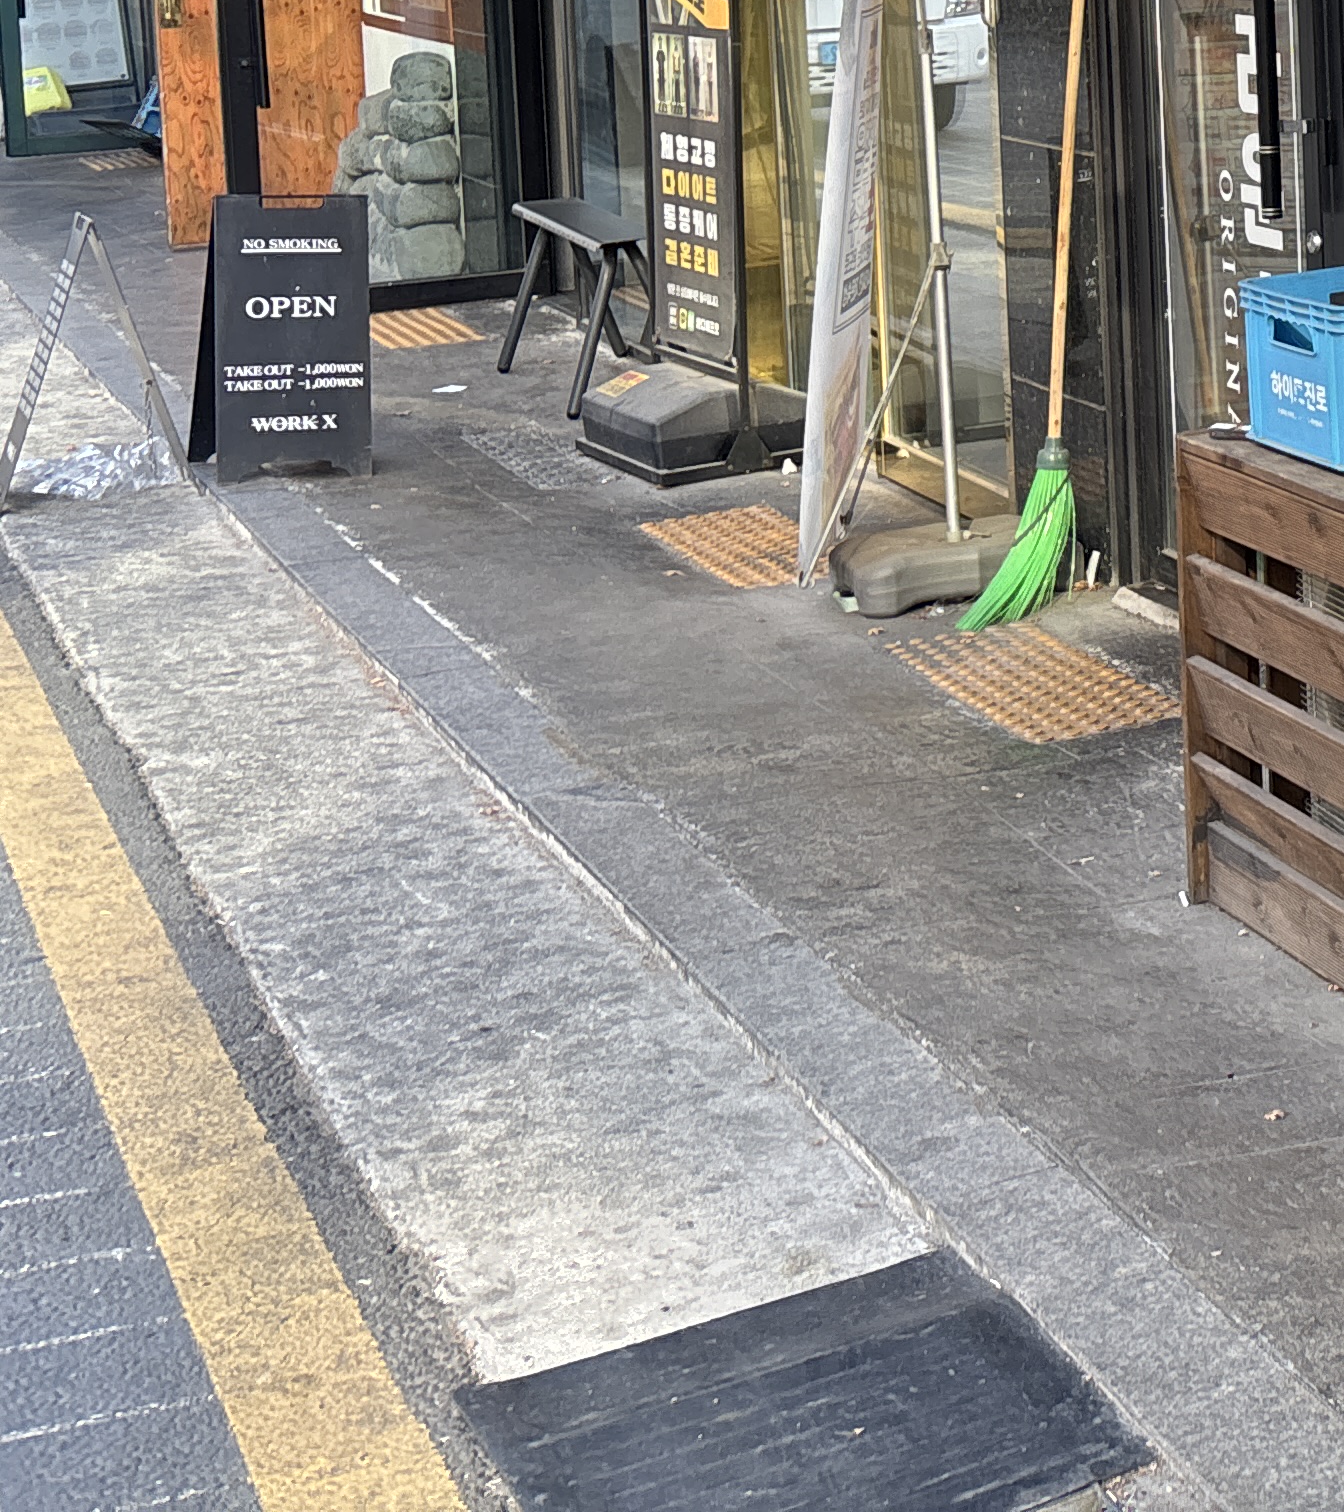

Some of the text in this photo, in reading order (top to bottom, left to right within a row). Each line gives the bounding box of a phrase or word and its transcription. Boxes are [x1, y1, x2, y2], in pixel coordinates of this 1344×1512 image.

[660, 131, 717, 169] 체형교정
[661, 168, 718, 205] 다이어트
[243, 238, 340, 250] NO SMOKING
[245, 295, 337, 319] OPEN
[224, 366, 263, 377] TAKE
[264, 364, 294, 376] OUT
[224, 379, 263, 392] TAKE
[264, 378, 294, 391] OUT
[1269, 369, 1329, 413] 하이트진로
[251, 414, 338, 433] WORK X
